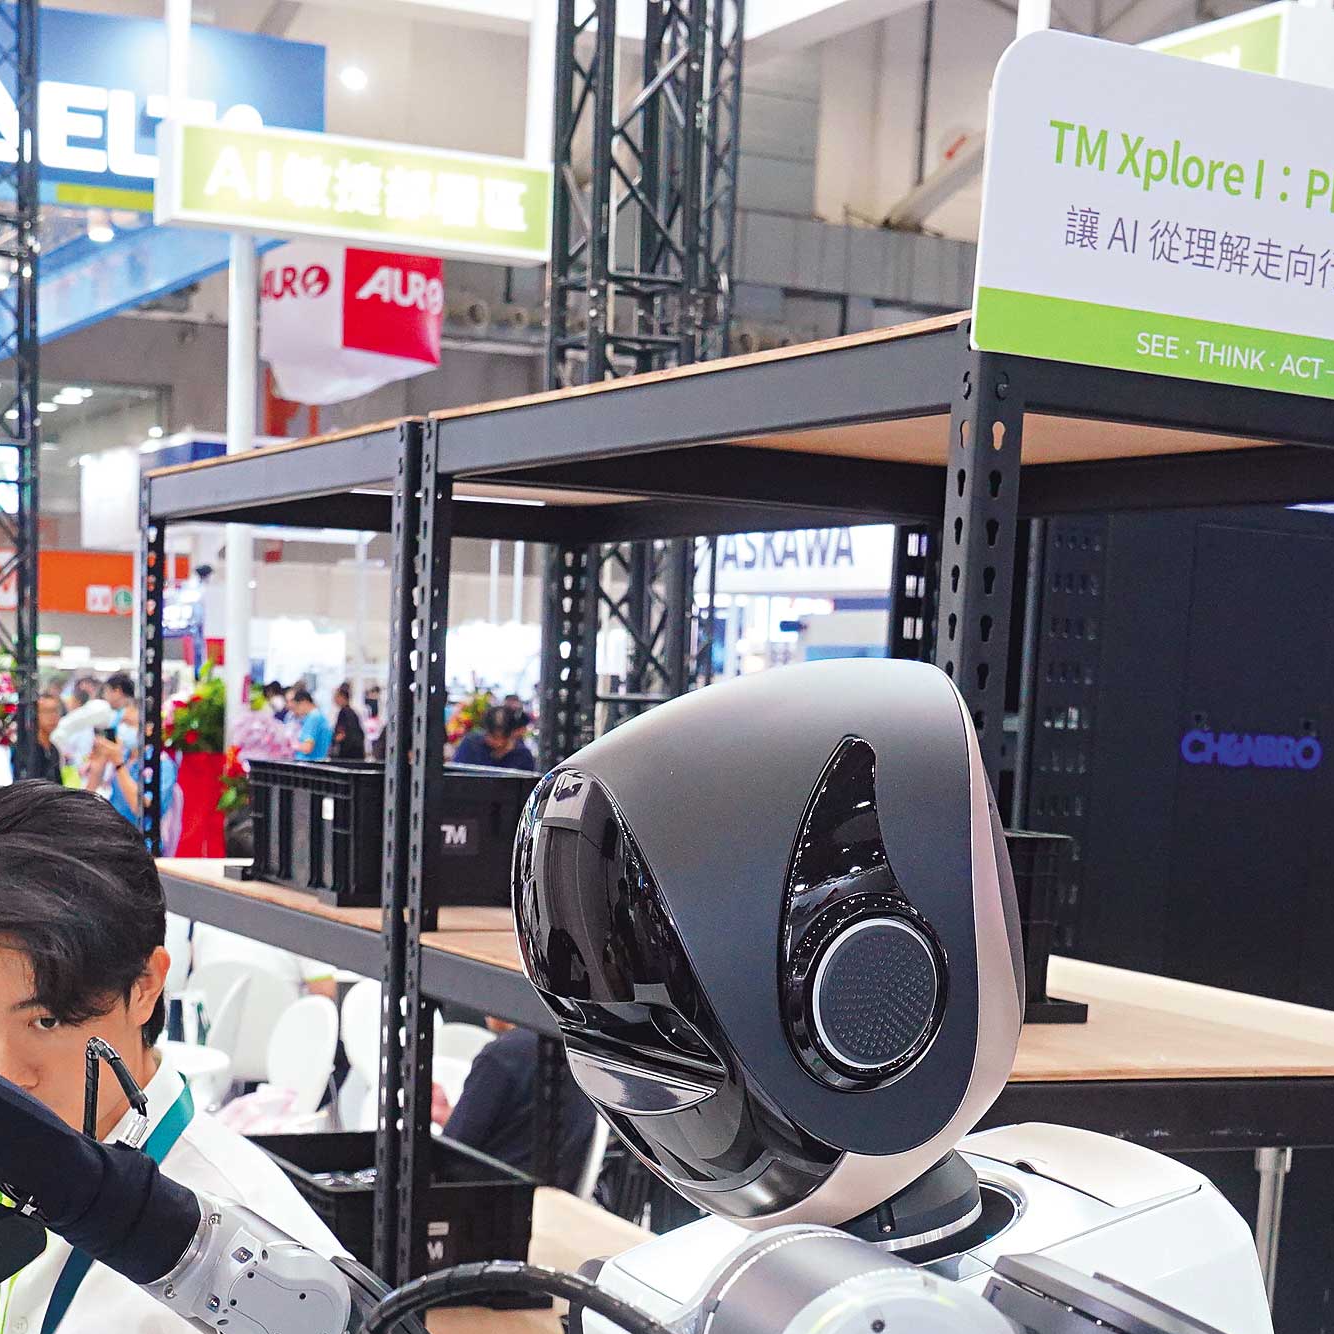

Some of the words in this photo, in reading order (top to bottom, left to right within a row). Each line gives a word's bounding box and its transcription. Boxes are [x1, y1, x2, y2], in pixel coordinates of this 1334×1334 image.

[1049, 118, 1109, 172] TM
[1116, 132, 1245, 197] Xplore
[1064, 204, 1101, 251] 讓
[1107, 216, 1140, 255] AI
[1135, 331, 1180, 361] SEE
[1195, 340, 1267, 373] THINK
